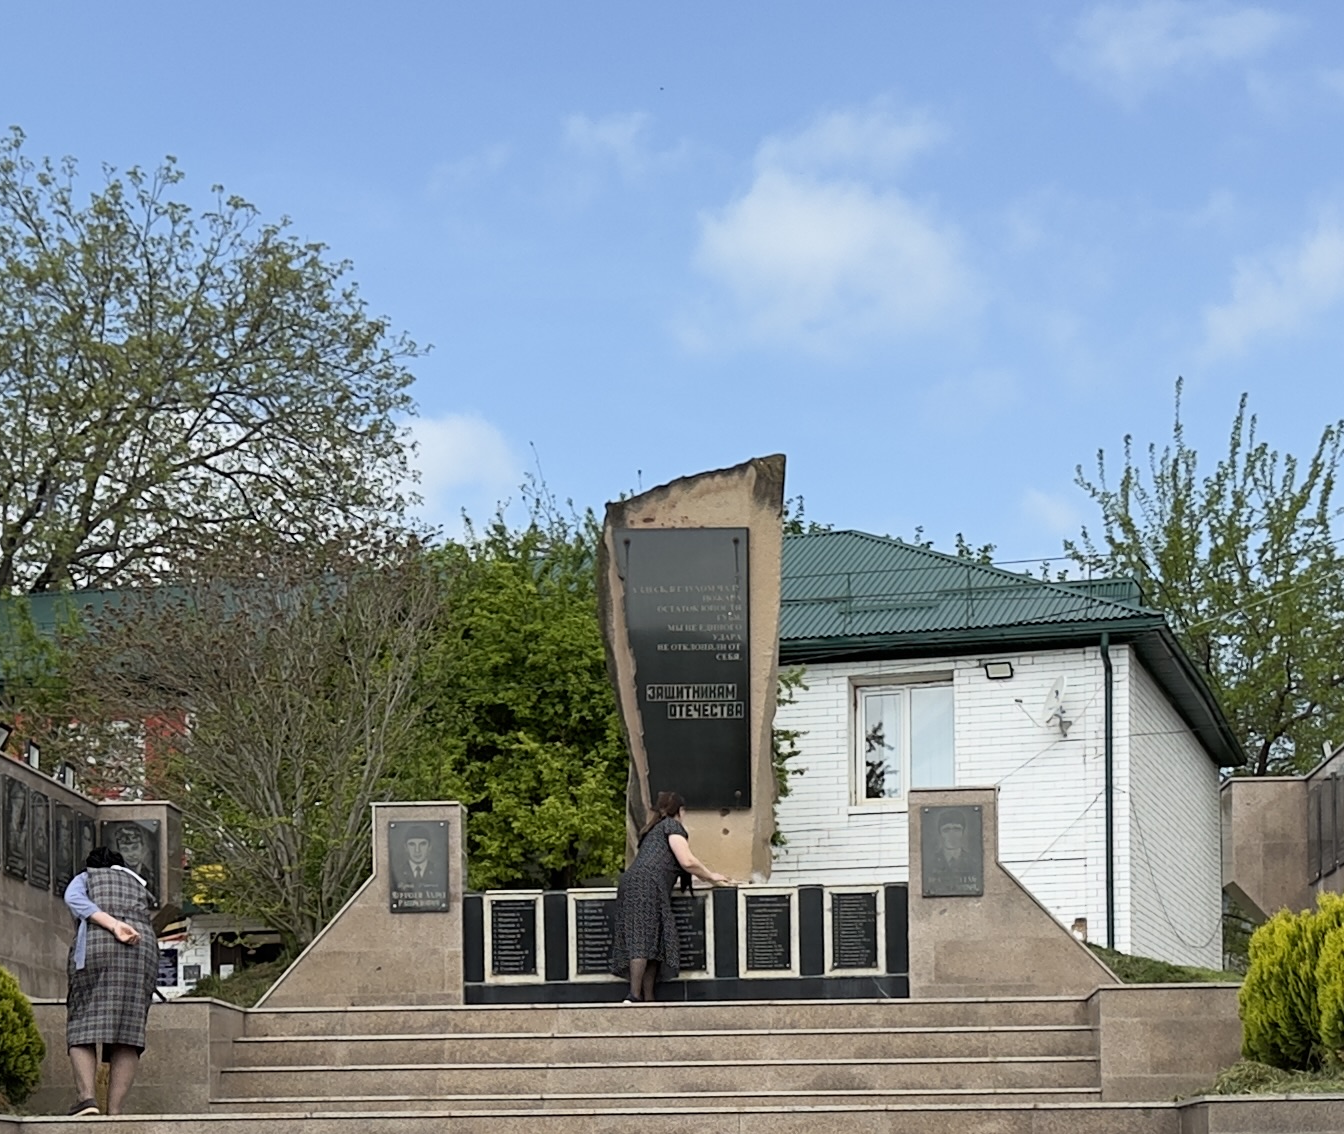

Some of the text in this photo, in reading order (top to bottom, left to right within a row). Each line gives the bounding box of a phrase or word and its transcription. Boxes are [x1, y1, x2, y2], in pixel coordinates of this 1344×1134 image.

[667, 624, 683, 632] МЫ
[699, 624, 742, 632] ЕДИНОГО
[657, 643, 669, 651] НЕ
[728, 643, 741, 651] ОТ
[648, 686, 735, 699] ЗАЩИТНИКАМ
[669, 704, 743, 717] ОТЕЧЕСТВА
